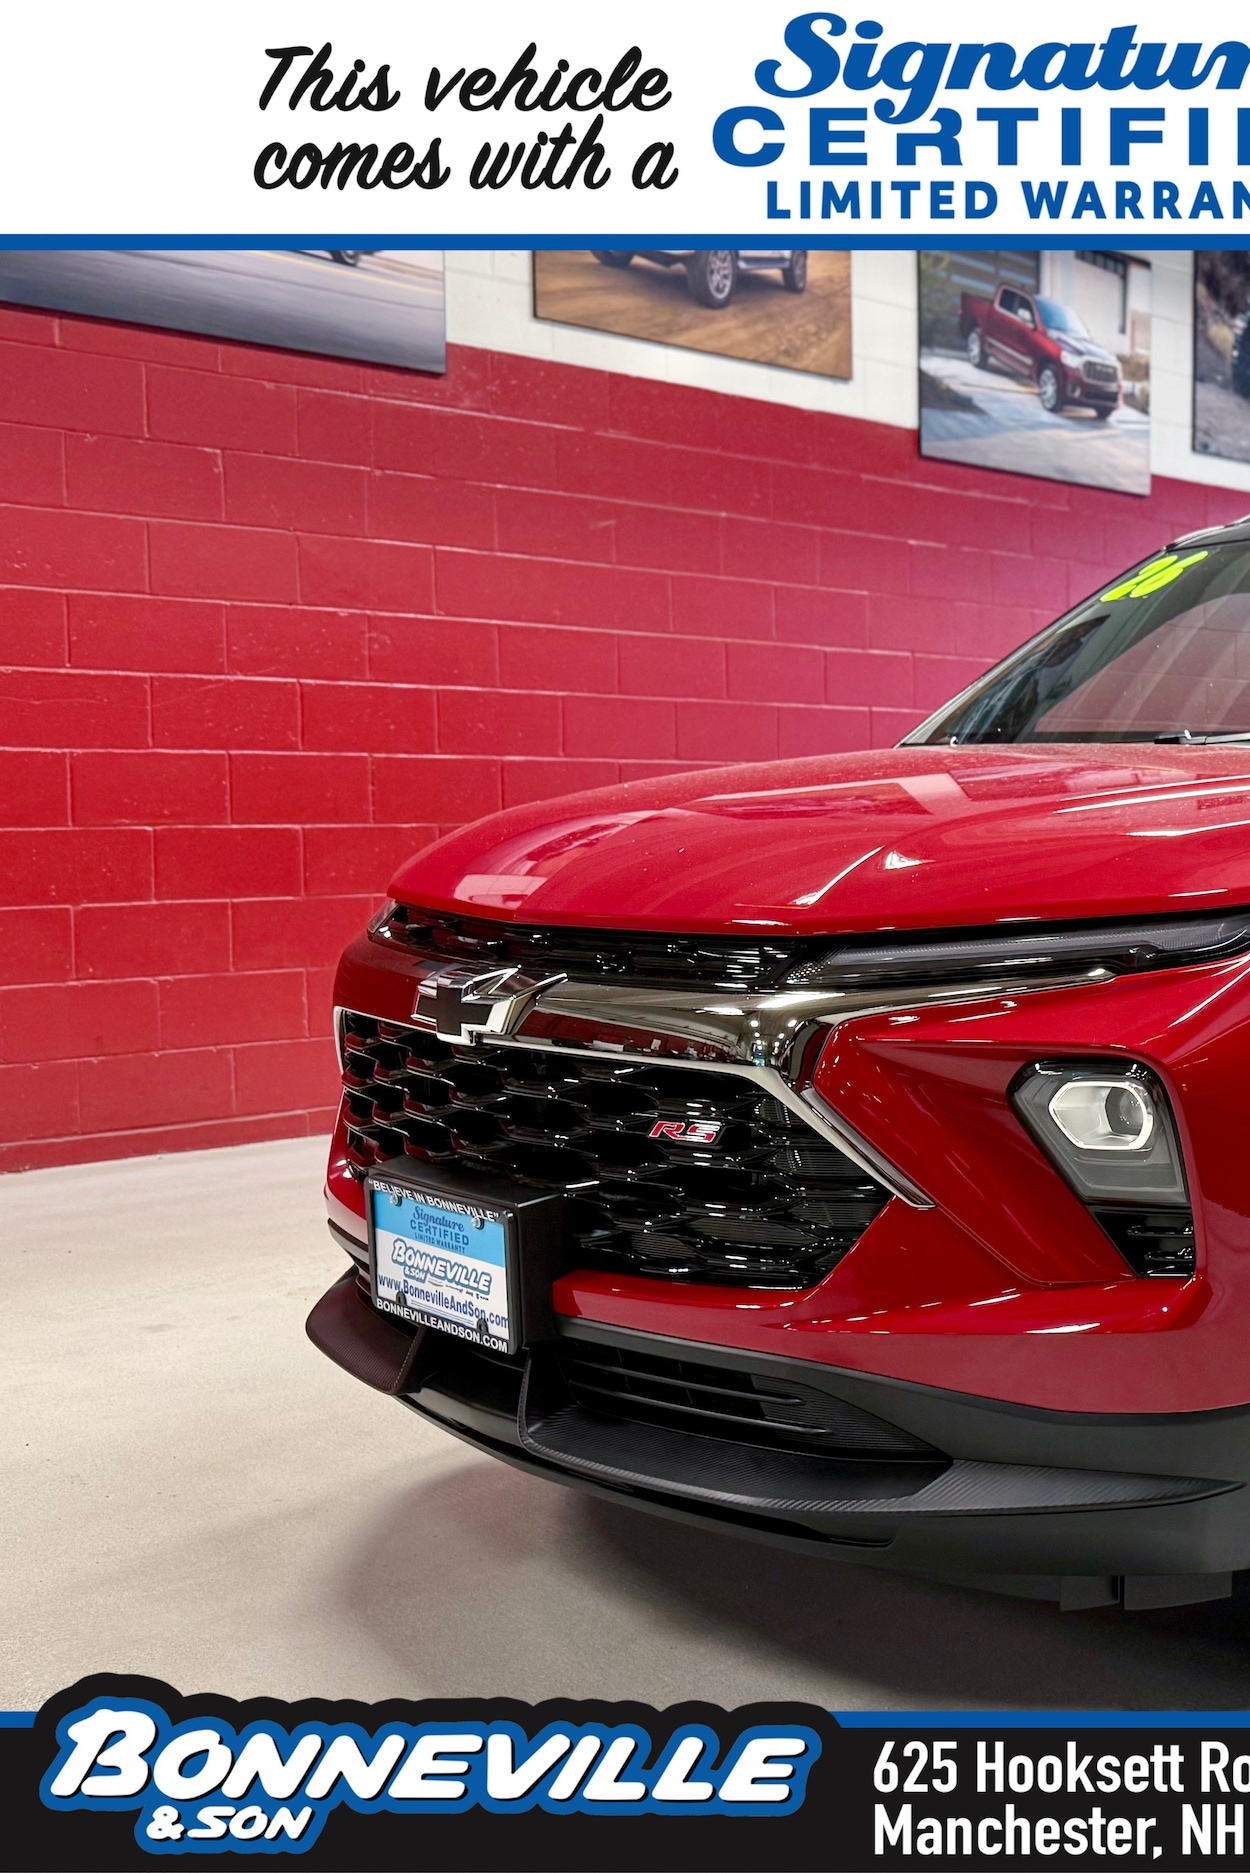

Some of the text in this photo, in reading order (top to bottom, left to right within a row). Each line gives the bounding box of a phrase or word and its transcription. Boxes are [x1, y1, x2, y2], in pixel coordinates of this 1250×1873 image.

[649, 1120, 722, 1144] RS
[414, 1192, 426, 1204] IN
[413, 1206, 465, 1232] Signature
[410, 1219, 470, 1246] CERTIFIED
[414, 1232, 466, 1254] LIMITED WARRANTY
[392, 1240, 491, 1293] BONNEVILLE
[378, 1274, 509, 1329] www.BonnevilleAndSon.com
[376, 1298, 508, 1354] BONNEVILLEANDSON.COM
